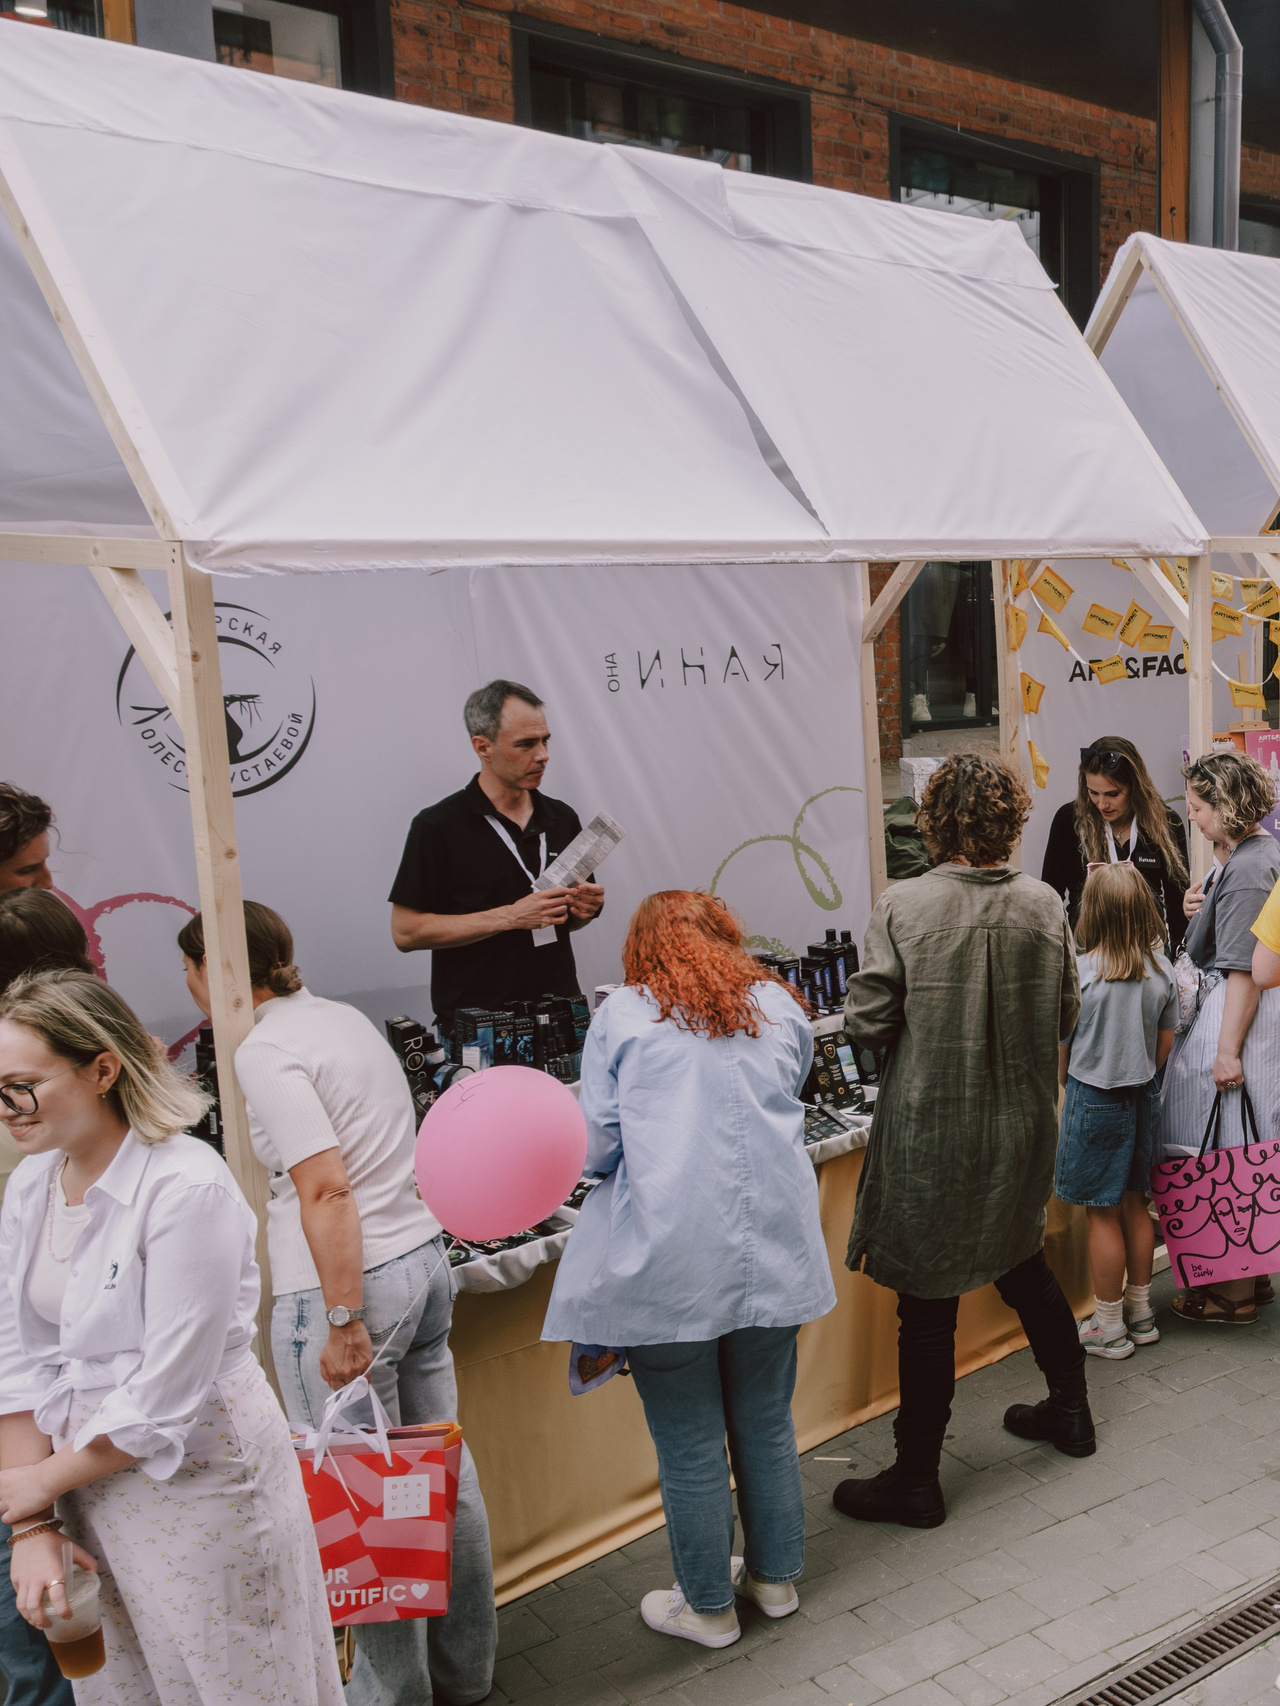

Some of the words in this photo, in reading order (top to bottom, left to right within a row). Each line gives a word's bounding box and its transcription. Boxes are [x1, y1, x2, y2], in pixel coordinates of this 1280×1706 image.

[604, 652, 621, 693] ОНА
[637, 643, 785, 690] ИНАЯ
[1068, 653, 1189, 683] AR&FAC
[141, 728, 189, 779] ОЛЕС
[230, 712, 304, 785] УСТАЕВОЙ
[1191, 1263, 1203, 1272] be
[1193, 1268, 1214, 1279] curly
[324, 1567, 350, 1585] UR
[330, 1584, 407, 1607] UTIFIC
